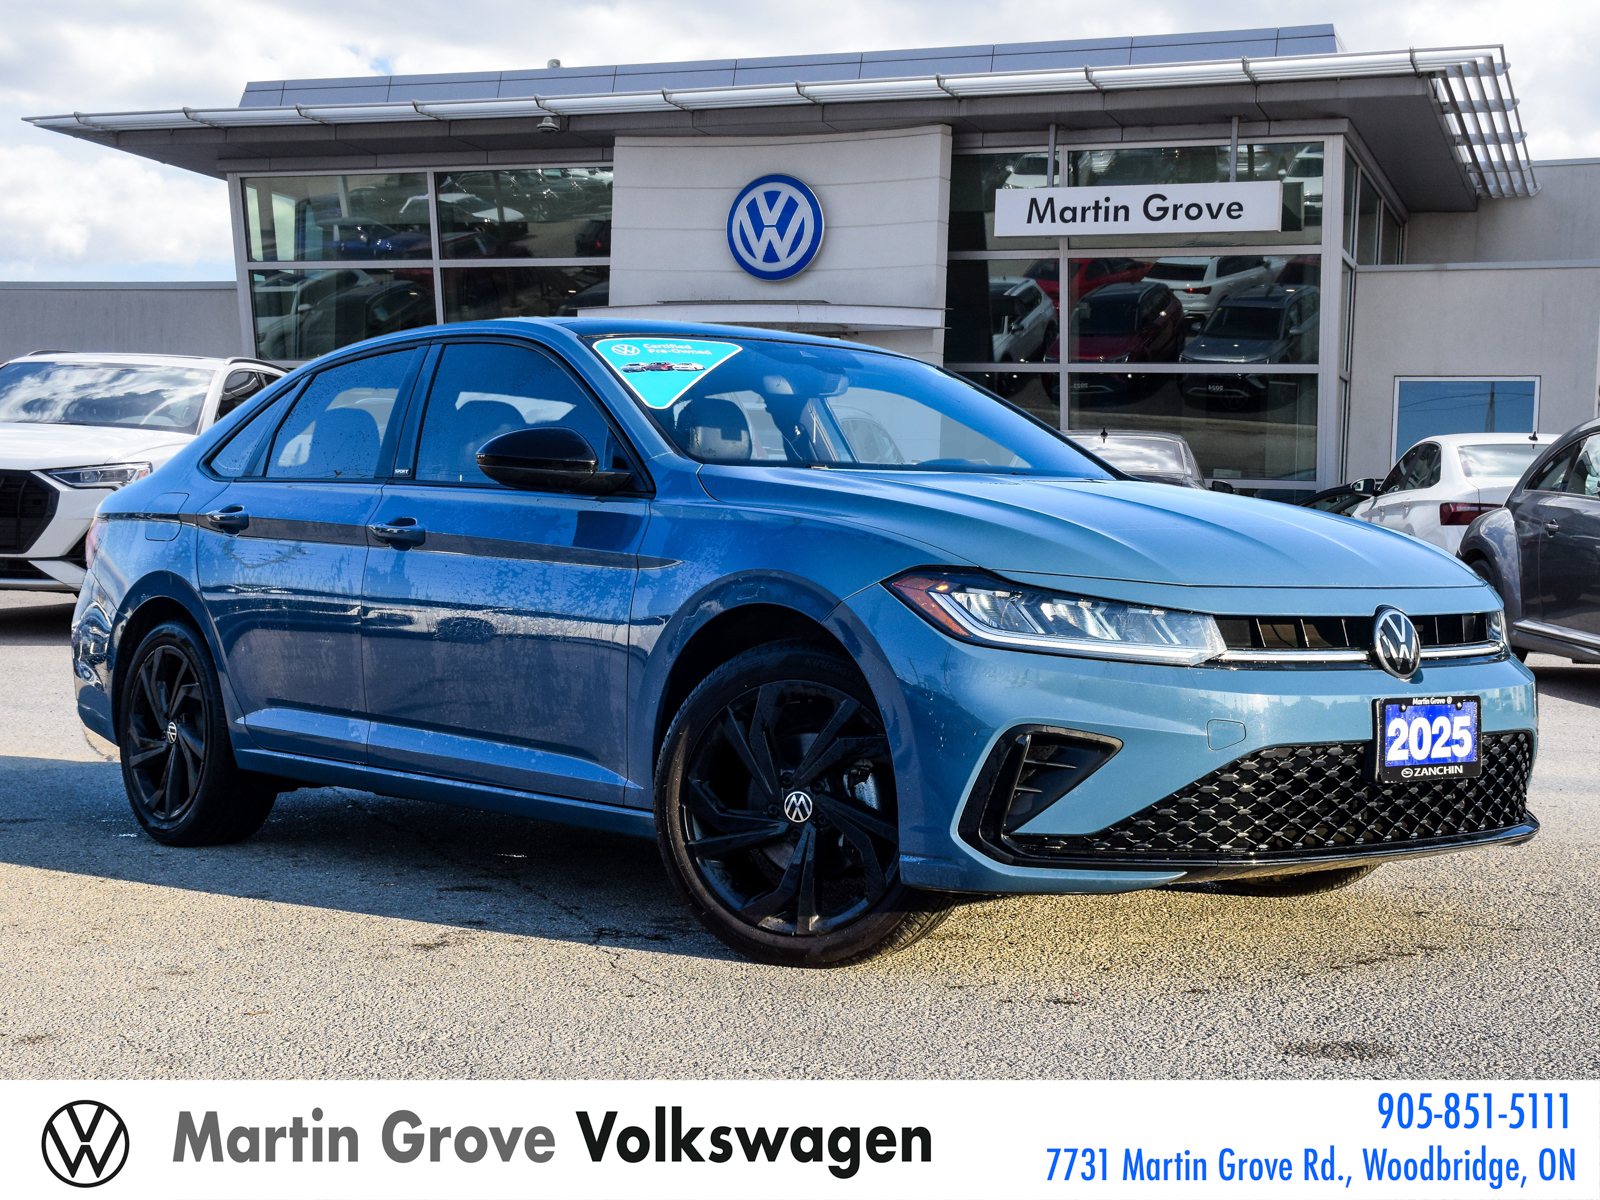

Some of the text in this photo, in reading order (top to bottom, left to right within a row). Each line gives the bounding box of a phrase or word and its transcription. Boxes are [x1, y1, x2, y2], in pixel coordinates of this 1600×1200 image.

[1027, 193, 1244, 224] Martin Grove
[730, 178, 818, 275] VW
[1412, 697, 1430, 706] Martin
[1430, 697, 1446, 705] Grove
[1387, 716, 1472, 761] 2025
[1414, 765, 1463, 777] ZANCHIN
